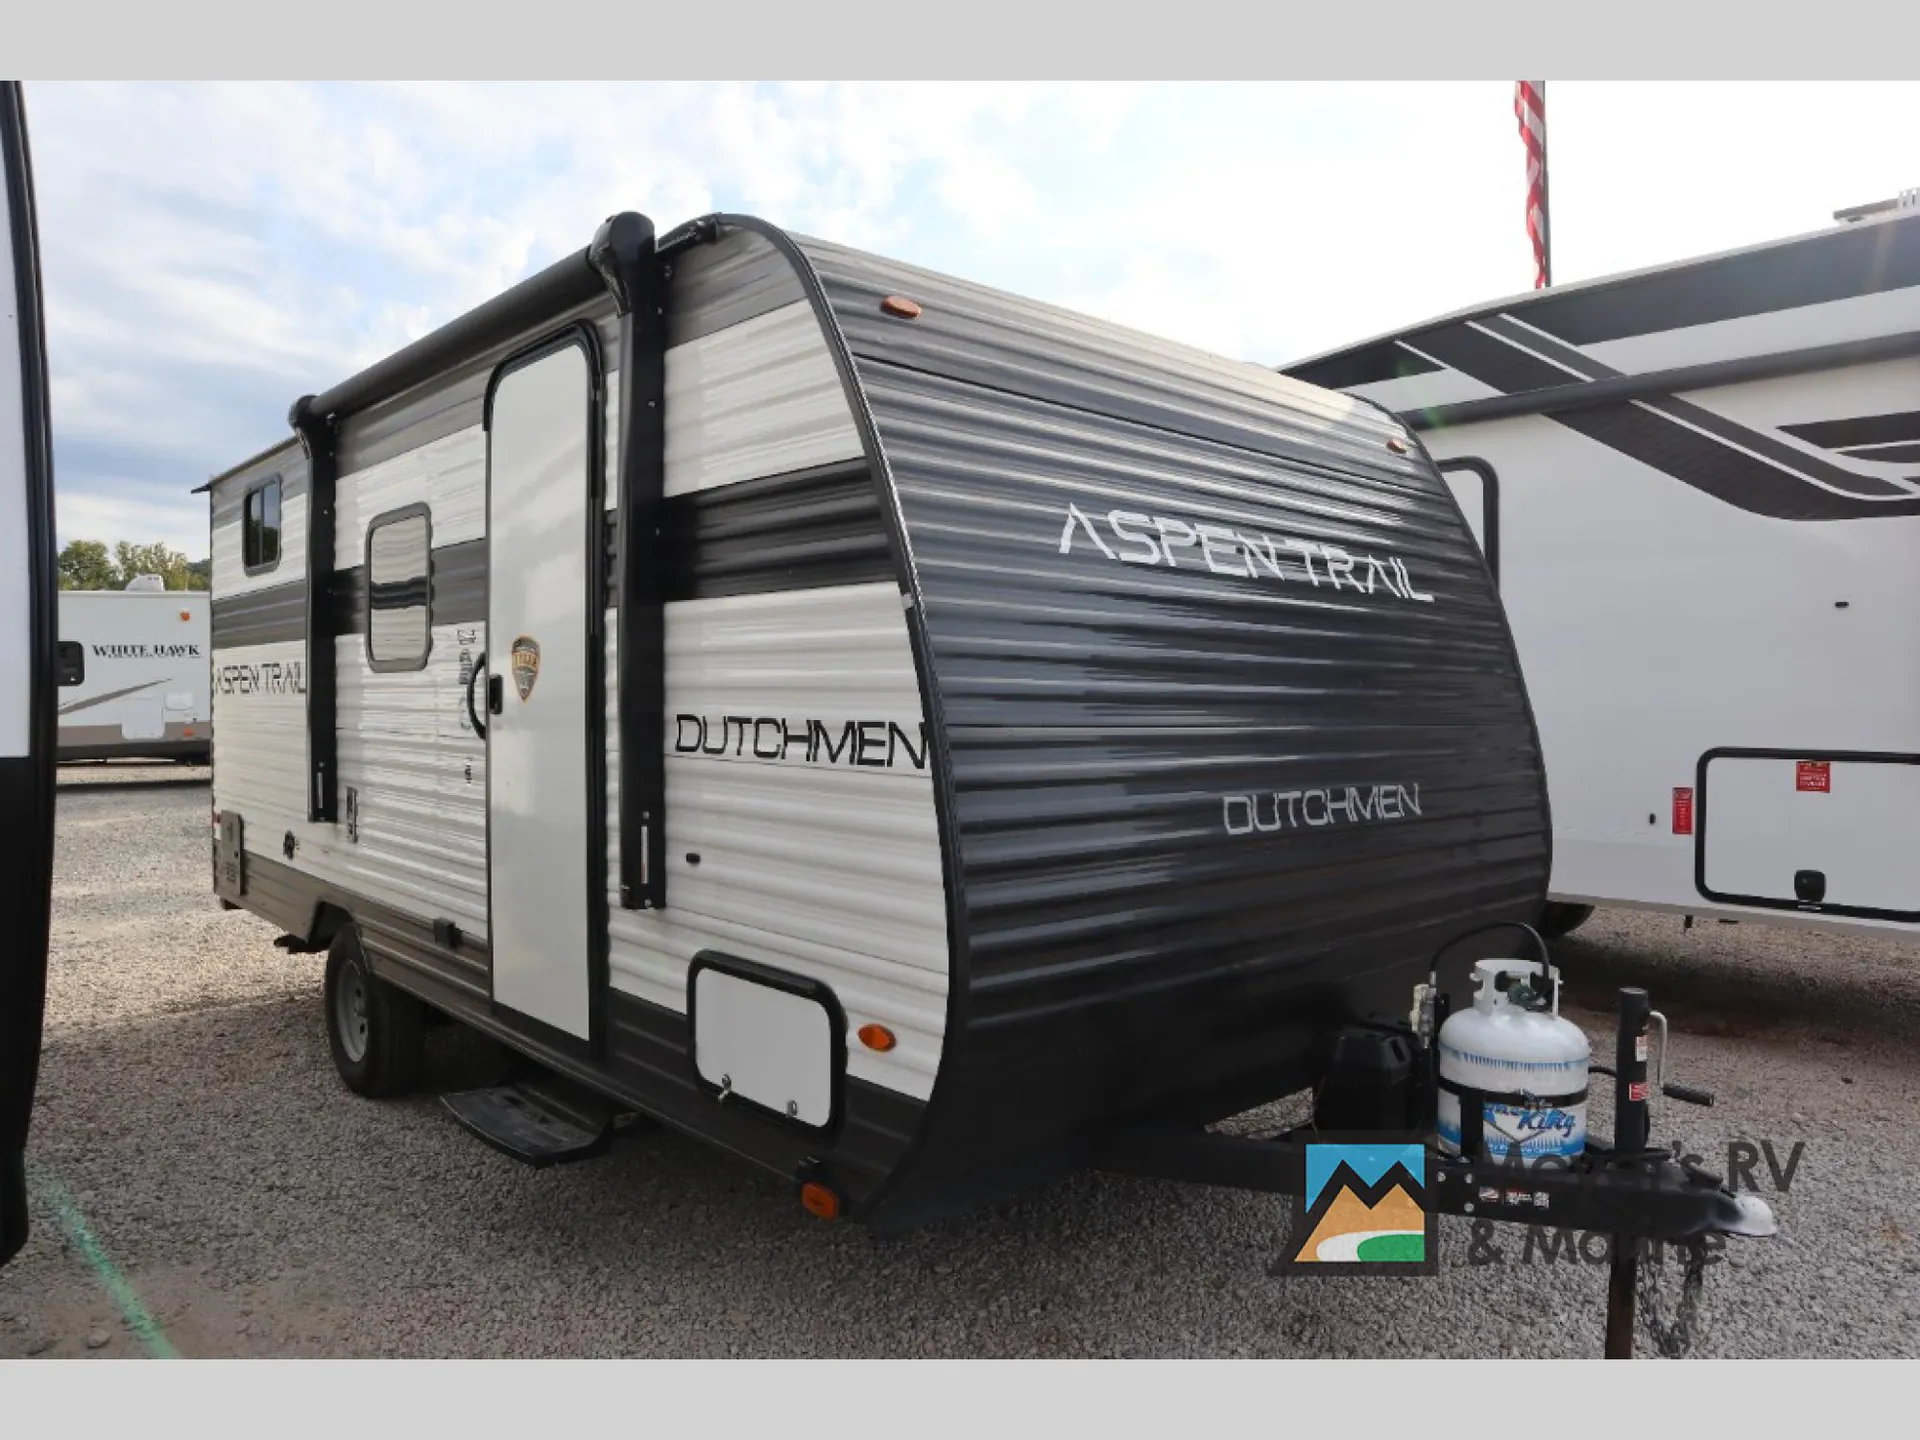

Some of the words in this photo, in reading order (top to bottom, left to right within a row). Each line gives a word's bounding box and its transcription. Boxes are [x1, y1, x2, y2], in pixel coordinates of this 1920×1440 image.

[1058, 501, 1285, 582] ASPEN
[1283, 536, 1435, 603] TRAIL
[92, 644, 148, 658] WHITE
[153, 644, 200, 657] HAWK
[215, 664, 259, 696] ASPEN
[261, 660, 306, 694] TRAIL
[675, 713, 928, 770] DUTCHMEN
[1223, 782, 1423, 836] DUTCHMEN
[1516, 1108, 1577, 1139] King
